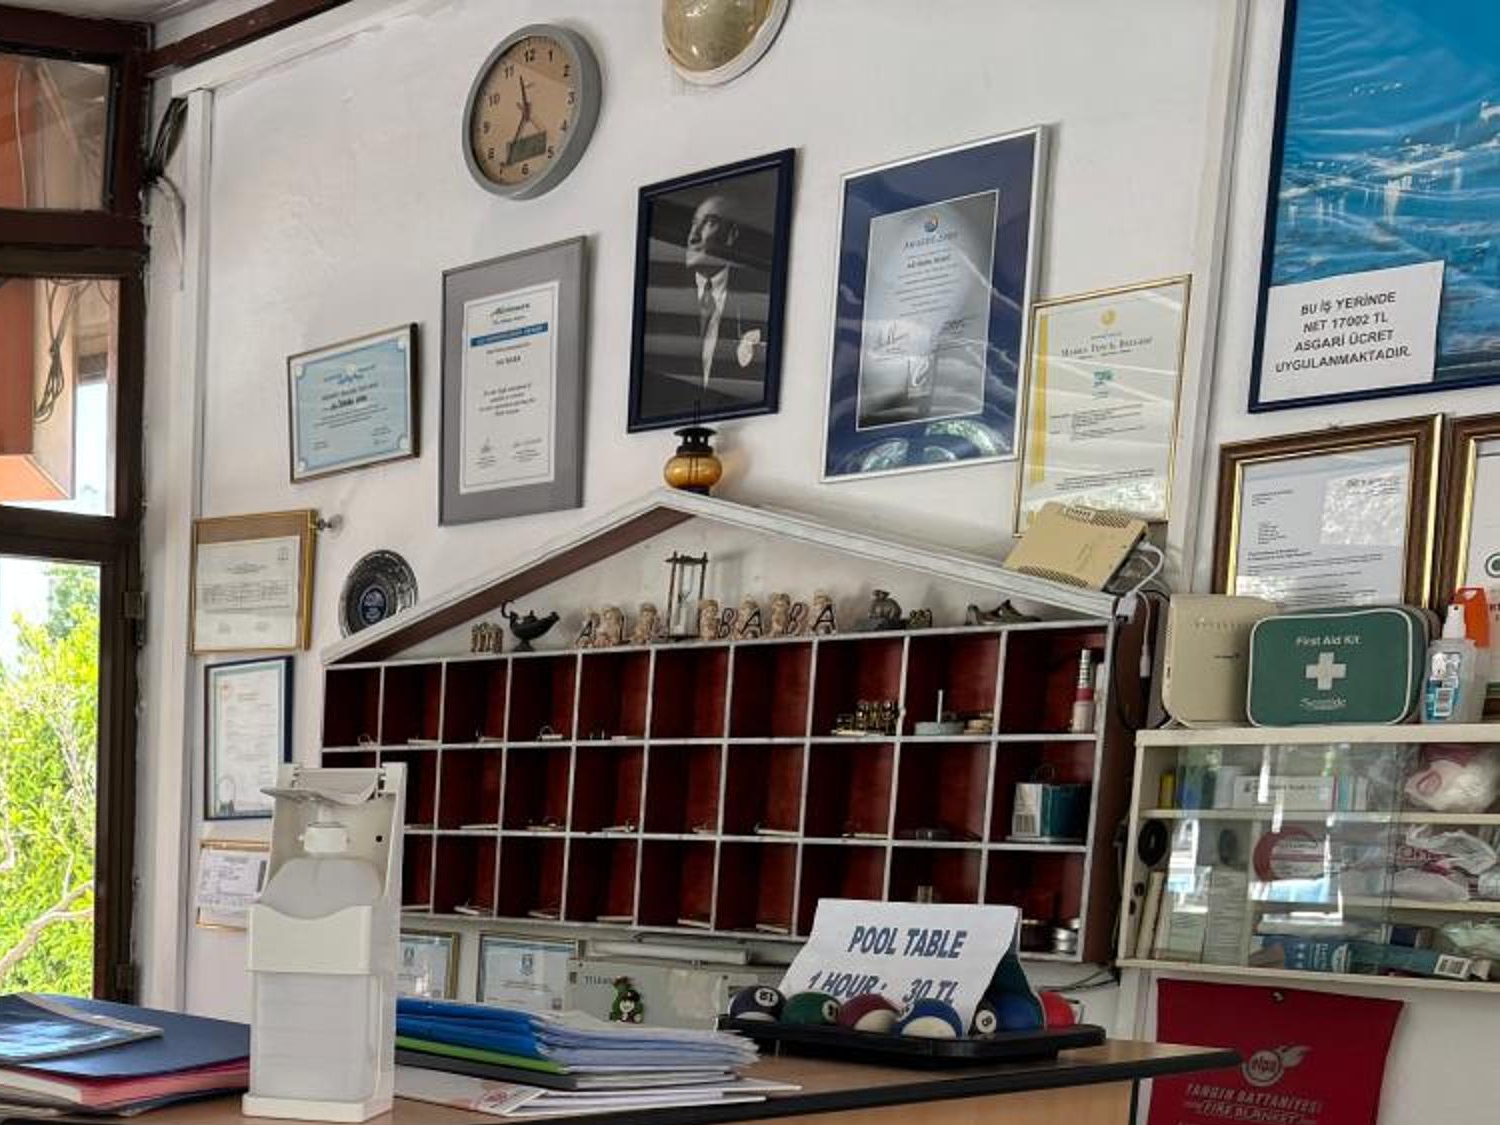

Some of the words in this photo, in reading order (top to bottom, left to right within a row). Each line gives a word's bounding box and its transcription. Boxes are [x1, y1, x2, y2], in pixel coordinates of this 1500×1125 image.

[1301, 304, 1318, 315] BU
[1336, 291, 1397, 309] YERİNDE
[1303, 319, 1328, 333] NET
[1332, 315, 1370, 329] 17002
[1374, 312, 1388, 323] TL
[1294, 334, 1345, 352] ASGARİ
[1349, 329, 1394, 345] ÜCRET
[1296, 635, 1321, 647] First
[1323, 635, 1341, 646] Aid
[1344, 635, 1361, 646] Kit
[847, 926, 898, 955] POOL
[903, 928, 967, 959] TABLE
[807, 970, 822, 989] 1
[902, 977, 934, 1003] 30
[935, 980, 959, 1004] TL
